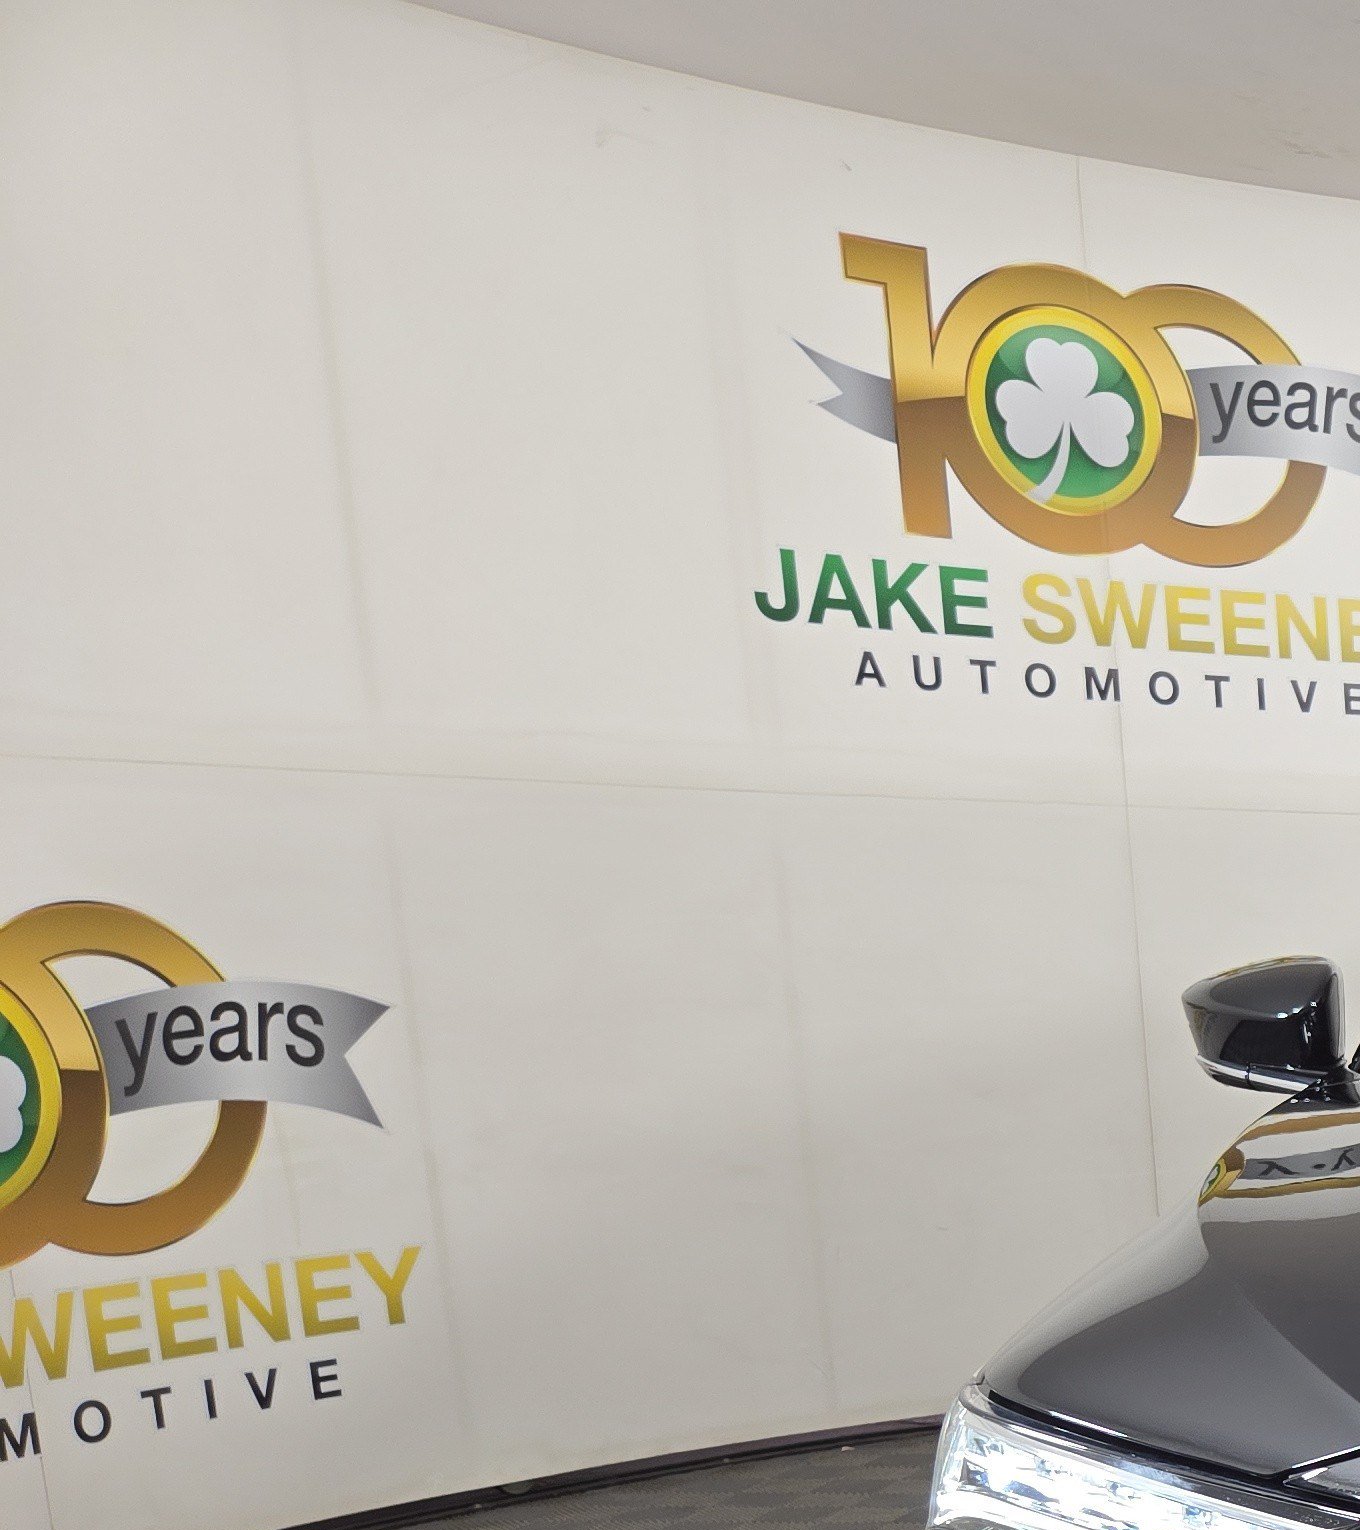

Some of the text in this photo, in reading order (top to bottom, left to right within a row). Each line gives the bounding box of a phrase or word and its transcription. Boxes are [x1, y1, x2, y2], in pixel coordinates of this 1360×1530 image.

[838, 231, 1327, 568] 100
[754, 547, 995, 640] JAKE
[114, 1000, 326, 1097] years
[0, 1357, 343, 1463] MOTIVE
